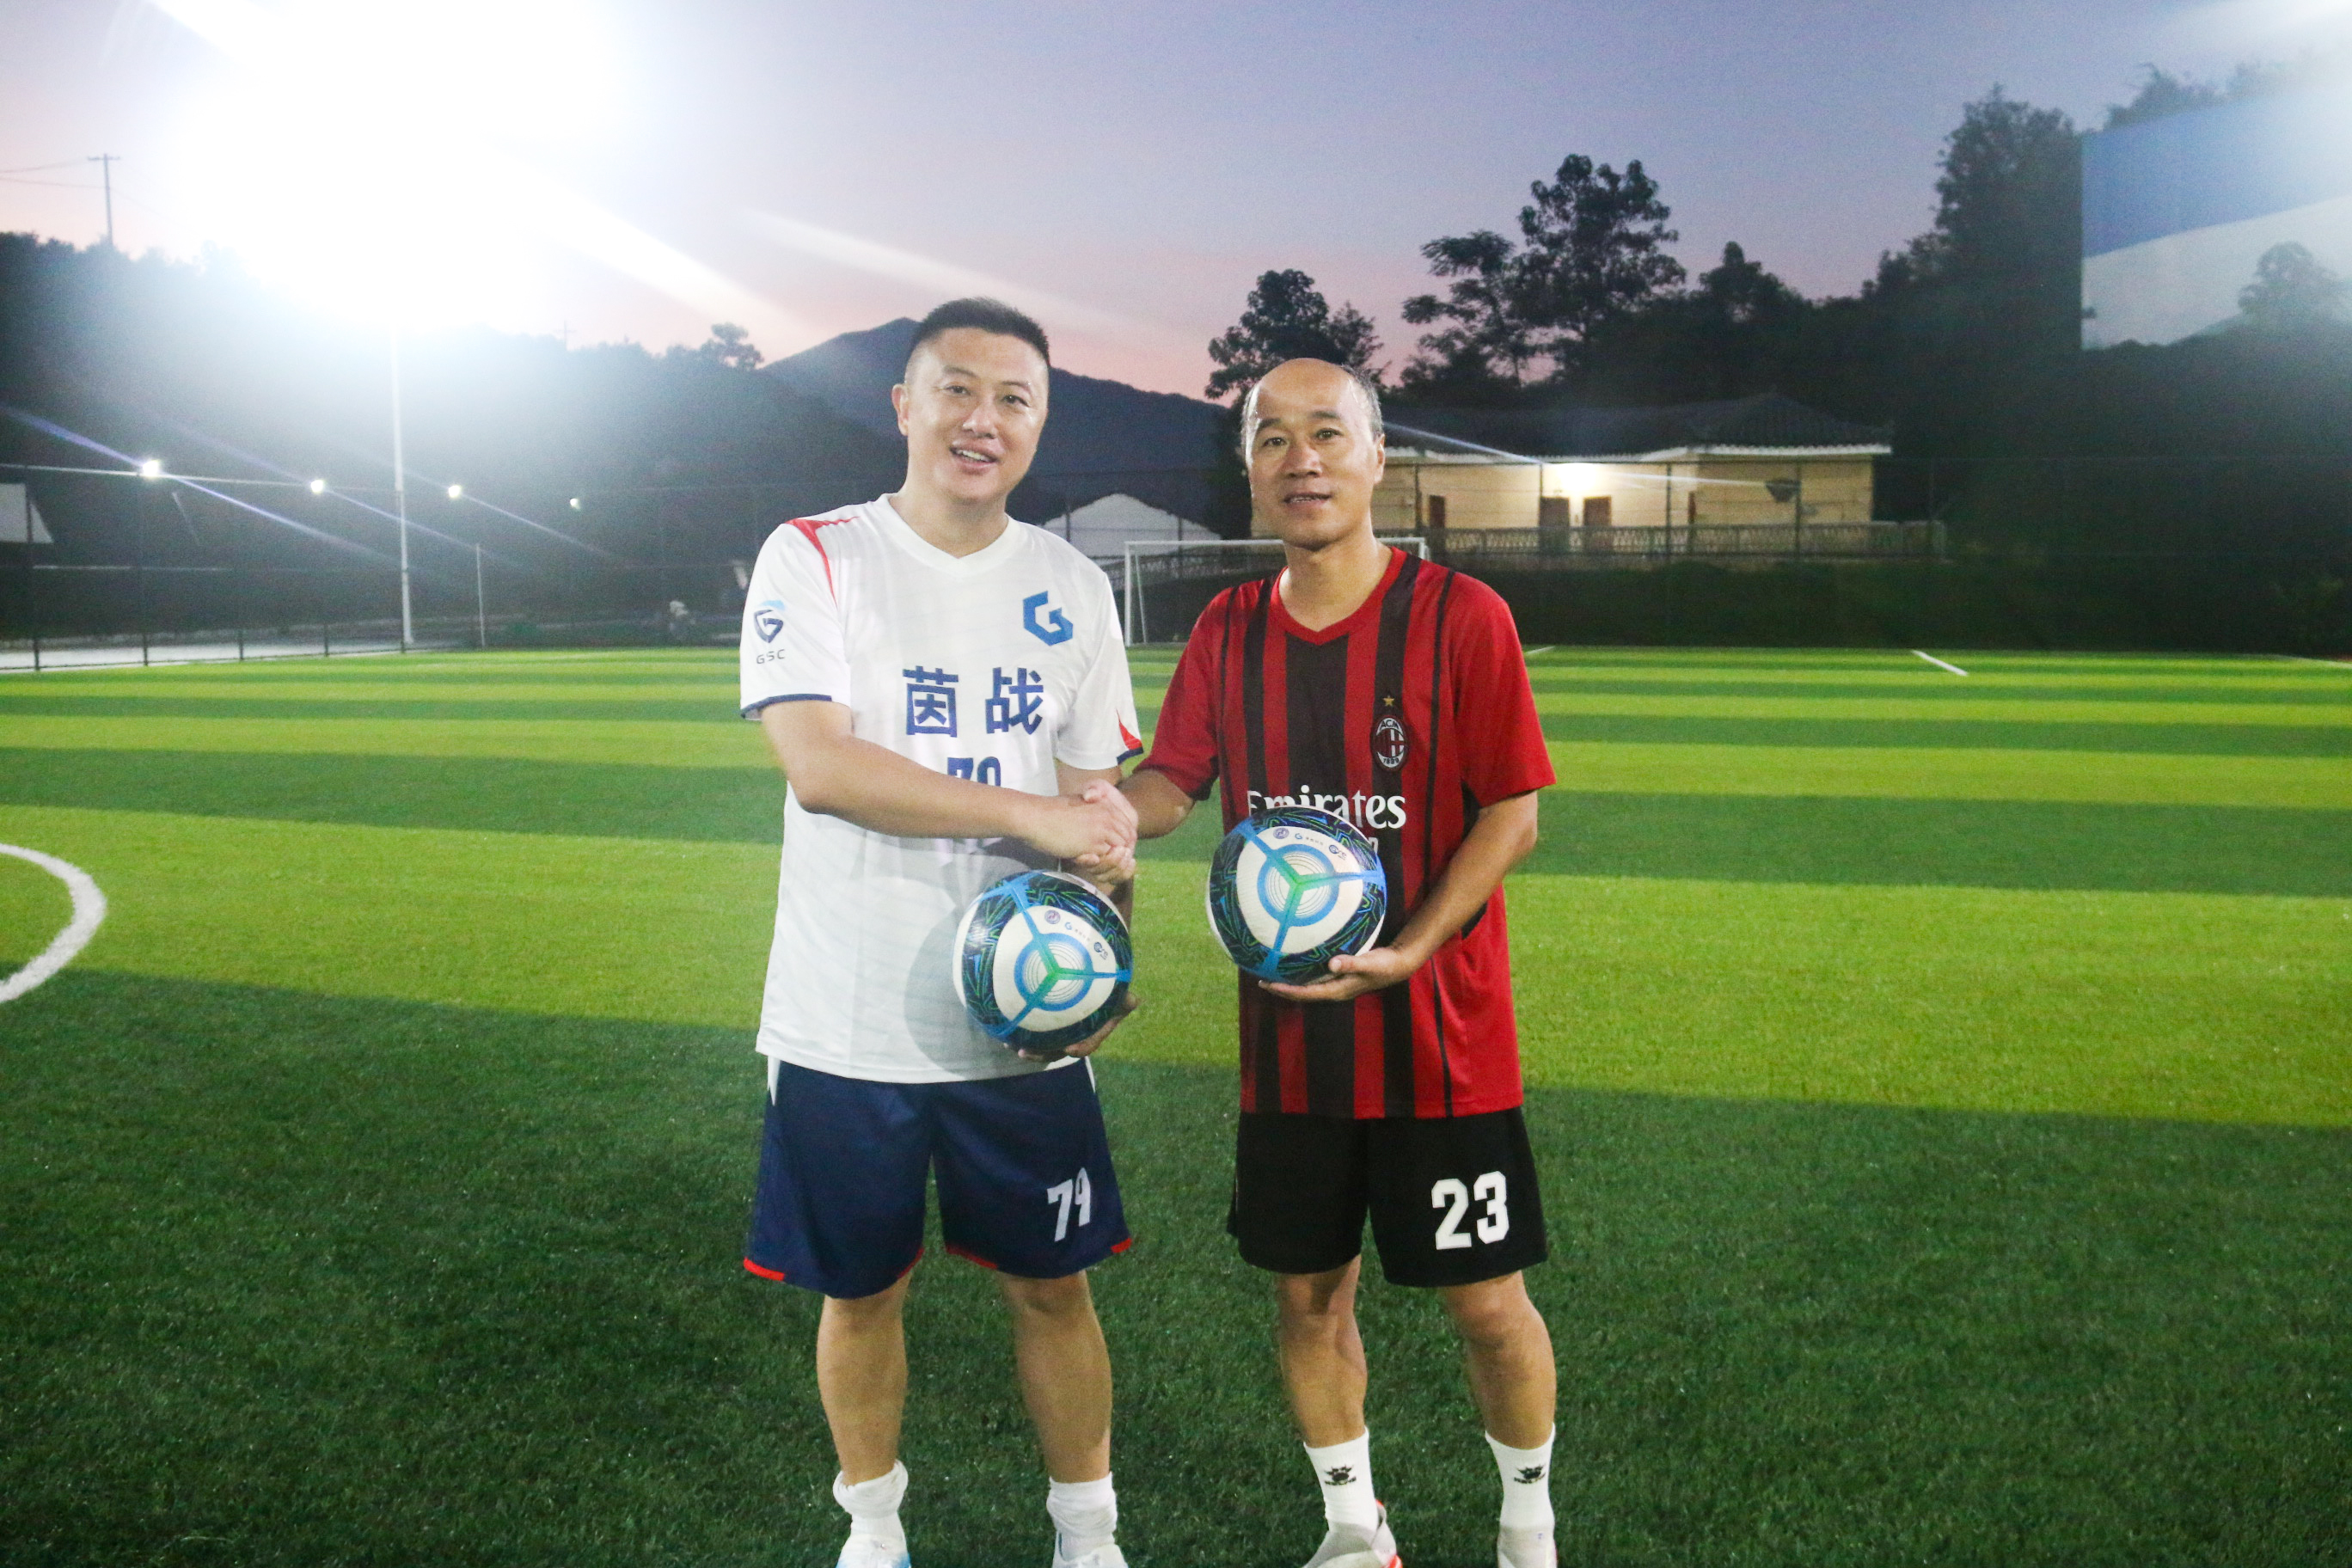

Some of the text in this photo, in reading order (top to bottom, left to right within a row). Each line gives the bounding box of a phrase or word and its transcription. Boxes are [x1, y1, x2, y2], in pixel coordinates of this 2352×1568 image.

[756, 648, 786, 665] GSC
[903, 665, 1044, 738] 茵战
[1431, 1170, 1510, 1250] 23
